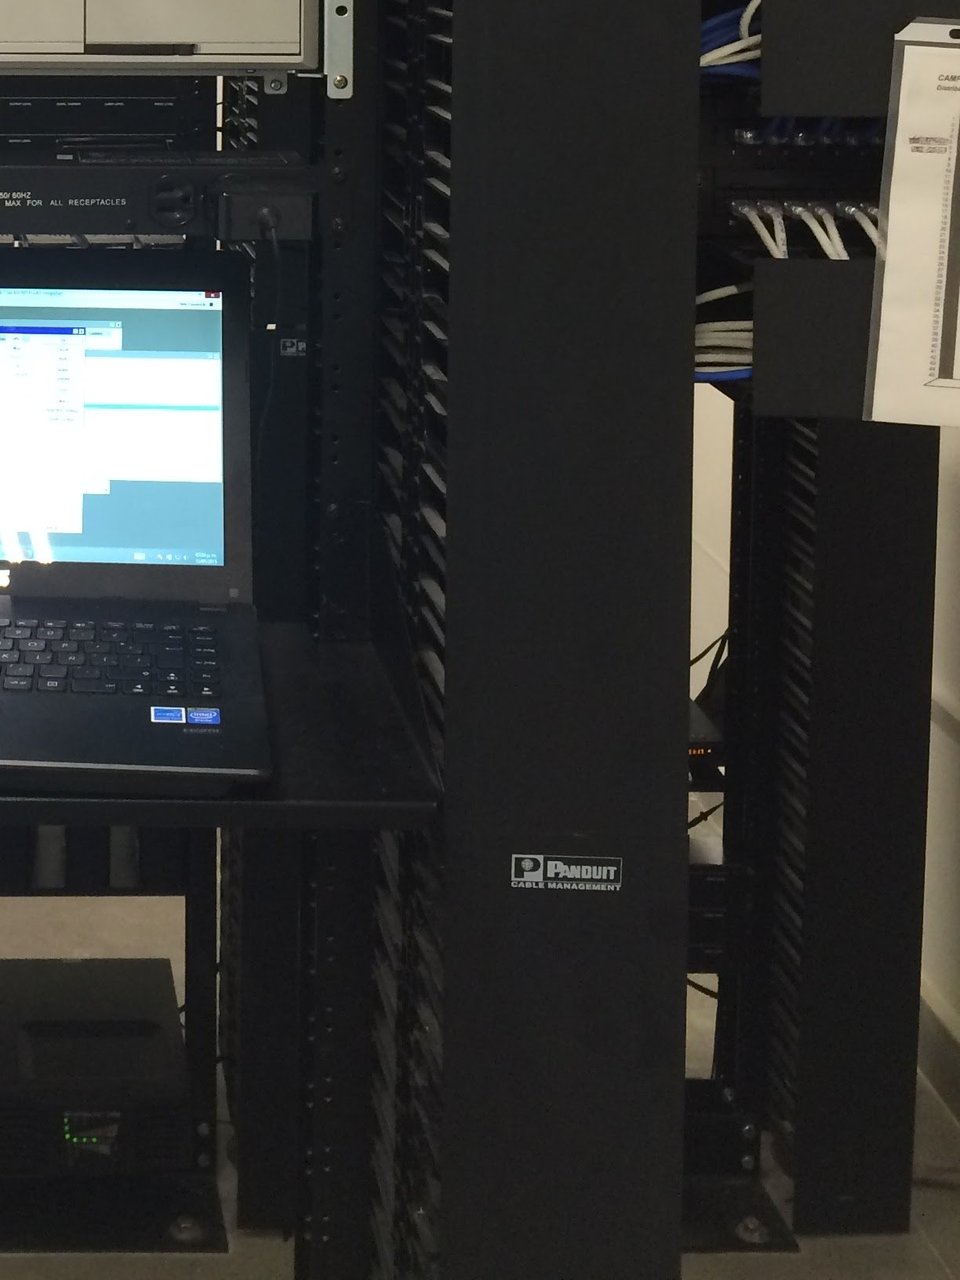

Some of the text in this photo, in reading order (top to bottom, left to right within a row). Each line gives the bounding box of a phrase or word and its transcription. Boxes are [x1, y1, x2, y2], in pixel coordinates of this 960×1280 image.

[26, 199, 43, 207] FOR
[68, 198, 127, 206] RECEPTACLES
[547, 861, 618, 880] PANDUIT
[511, 881, 621, 891] CABLE MANAGEMENT
